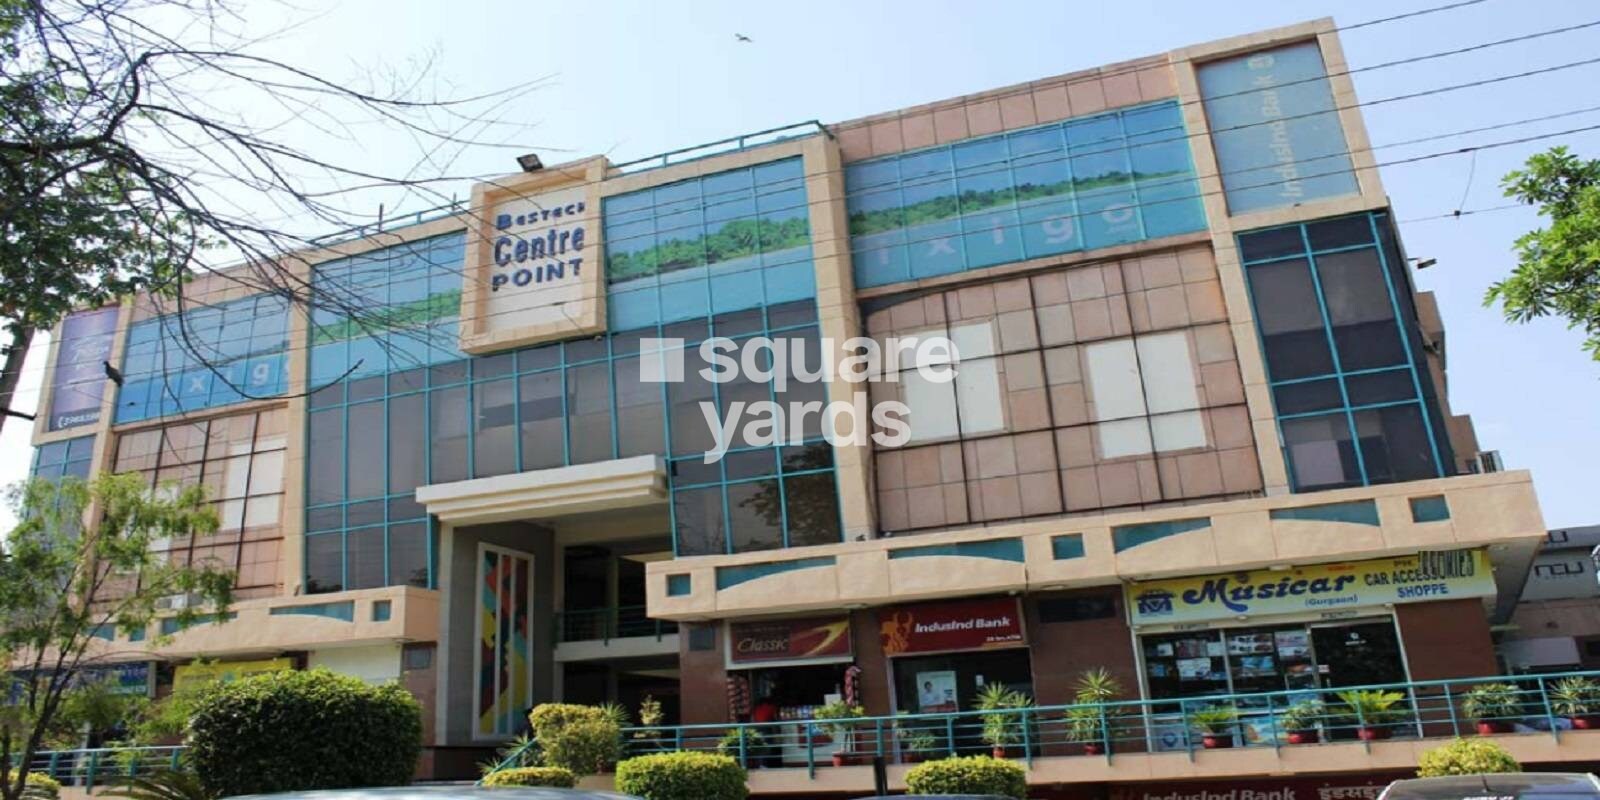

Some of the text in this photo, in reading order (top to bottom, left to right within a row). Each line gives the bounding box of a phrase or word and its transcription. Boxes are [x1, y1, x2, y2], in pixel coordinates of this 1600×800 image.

[1251, 74, 1282, 118] Bank
[494, 227, 585, 267] Centre
[876, 203, 1134, 266] ixigo
[491, 258, 583, 292] POINT
[1364, 571, 1391, 586] CAR
[1397, 583, 1449, 599] SHOPPE
[1182, 574, 1355, 613] Musicar
[915, 616, 1010, 633] IndusInd Bank
[737, 637, 789, 653] Classic
[1239, 786, 1296, 800] Bank
